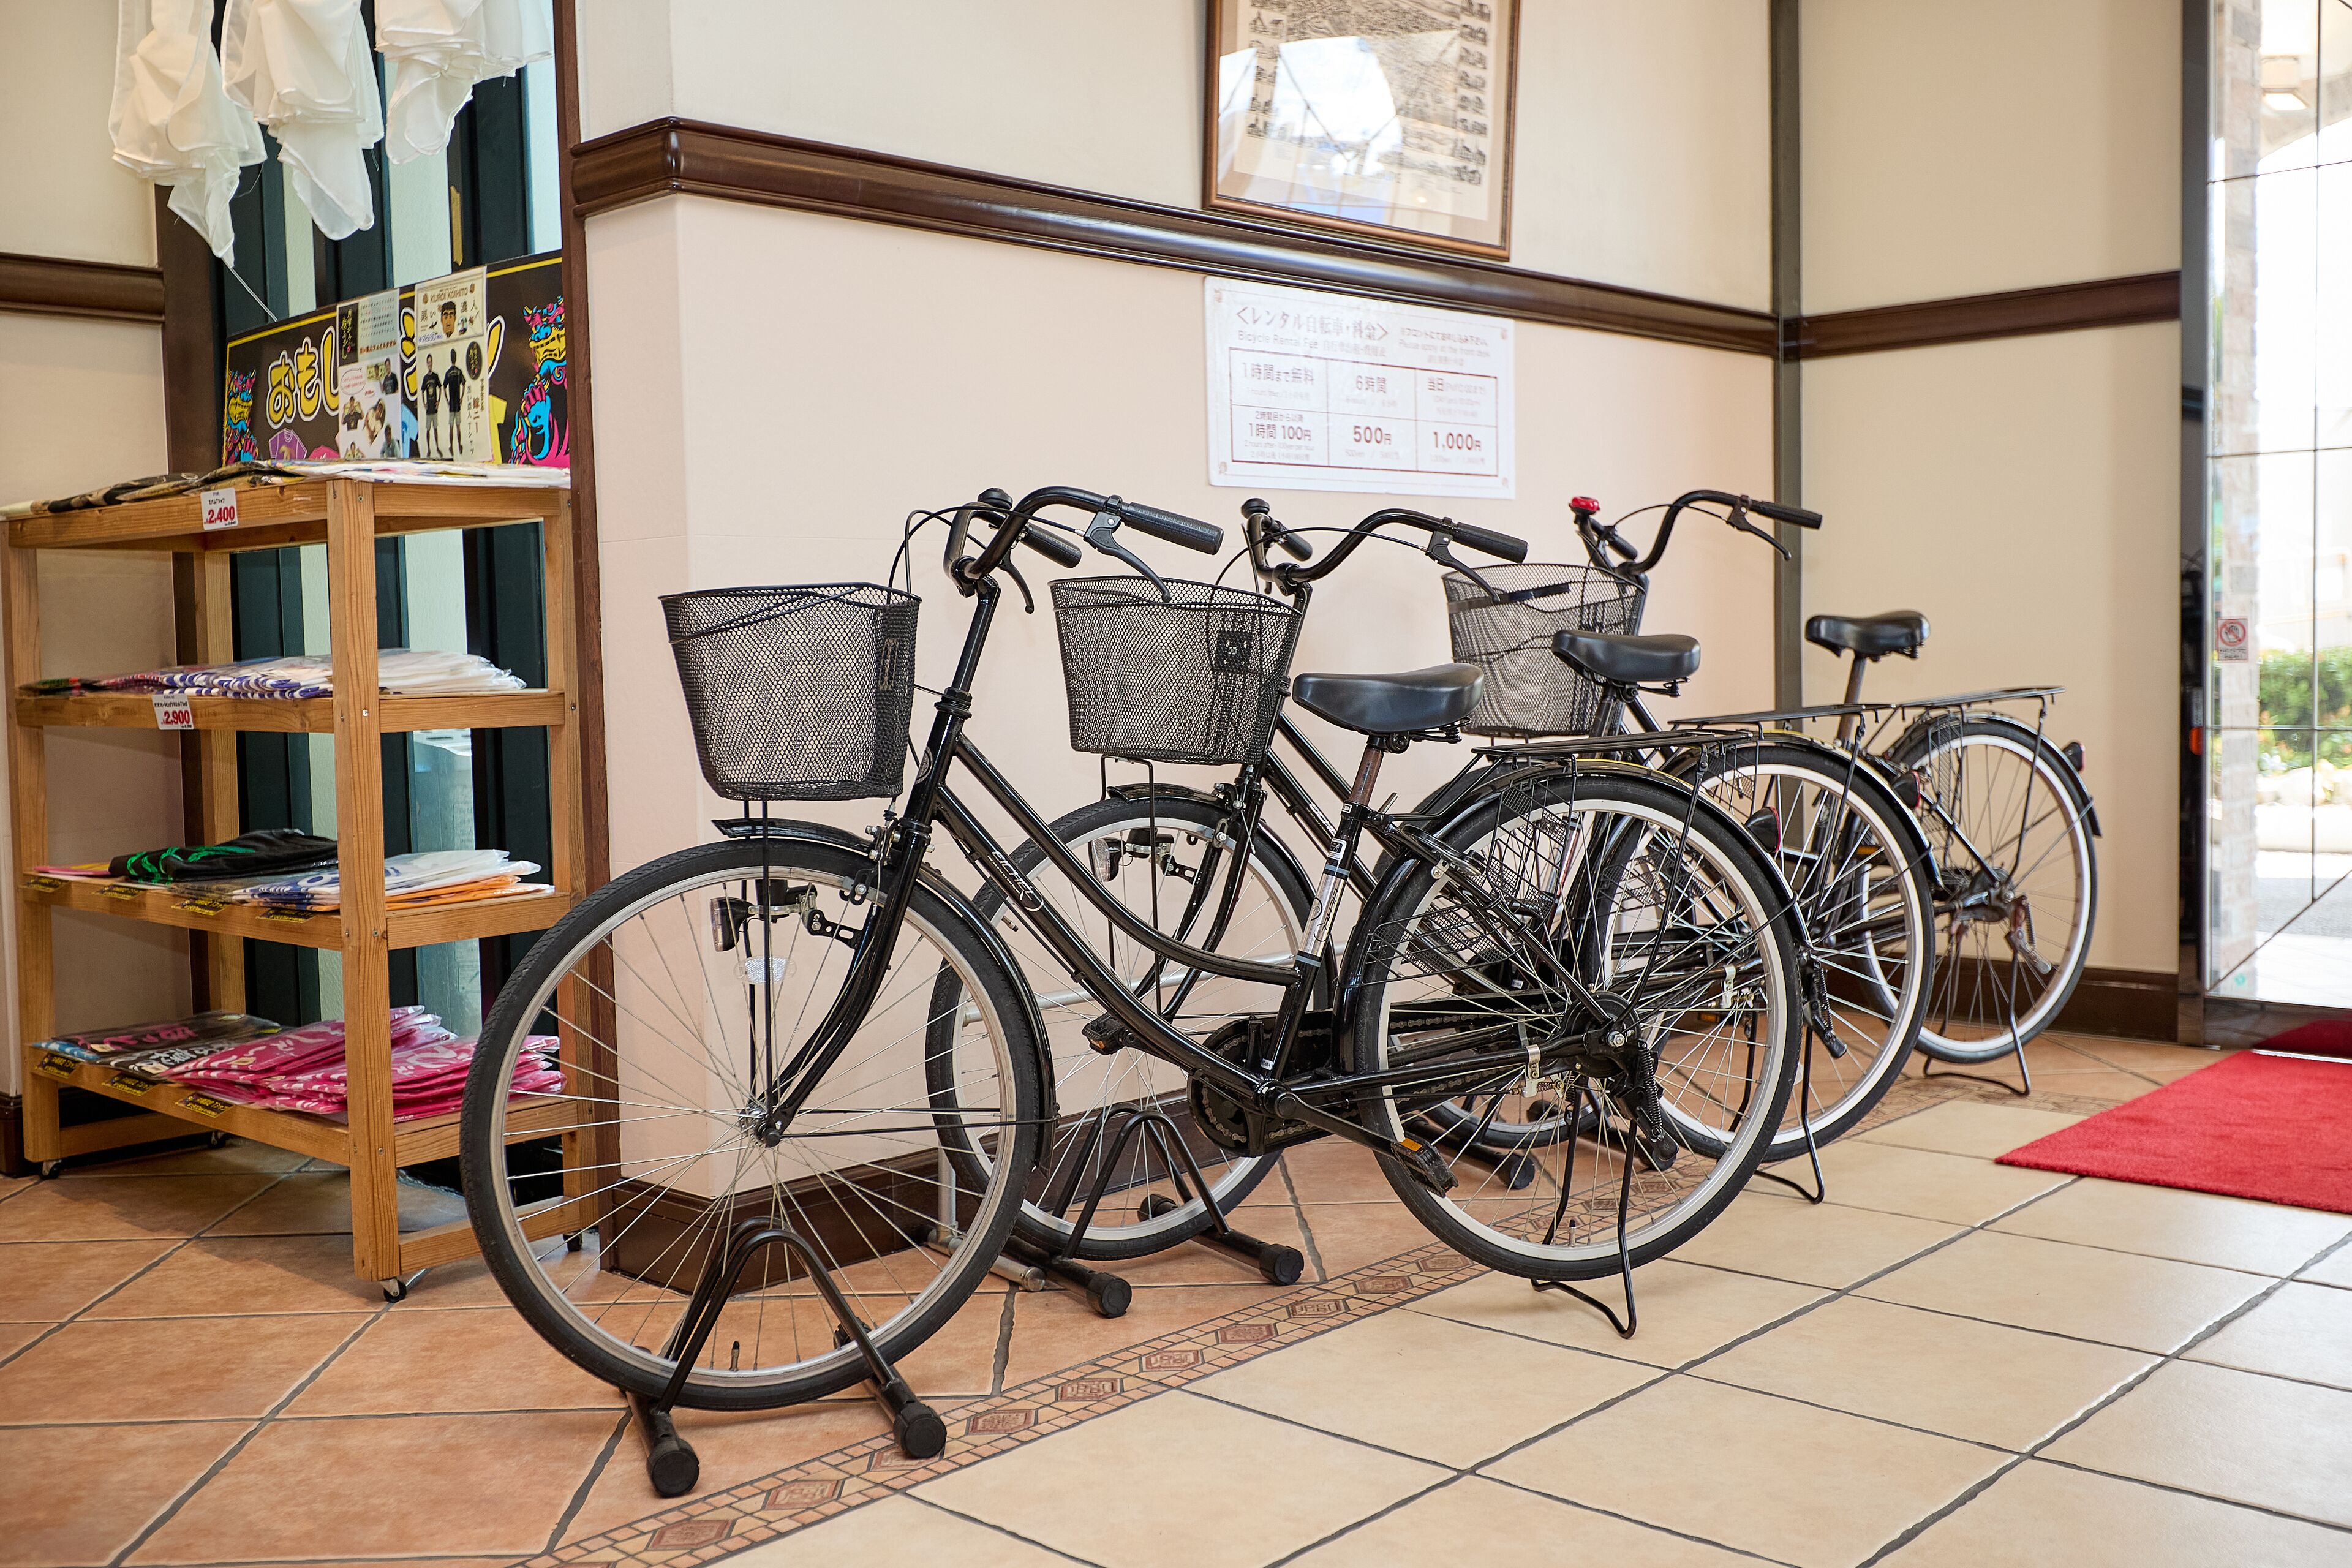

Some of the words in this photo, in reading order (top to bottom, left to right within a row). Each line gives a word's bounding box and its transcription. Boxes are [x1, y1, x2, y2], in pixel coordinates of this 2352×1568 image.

[1238, 330, 1269, 344] Bicycle
[1273, 334, 1300, 347] Rental
[1304, 337, 1318, 349] Fee
[1356, 375, 1387, 394] 6時間
[1249, 423, 1276, 439] 1時間
[1281, 425, 1311, 442] 100円
[1353, 425, 1392, 445] 500円
[992, 850, 1038, 907] EICHEL
